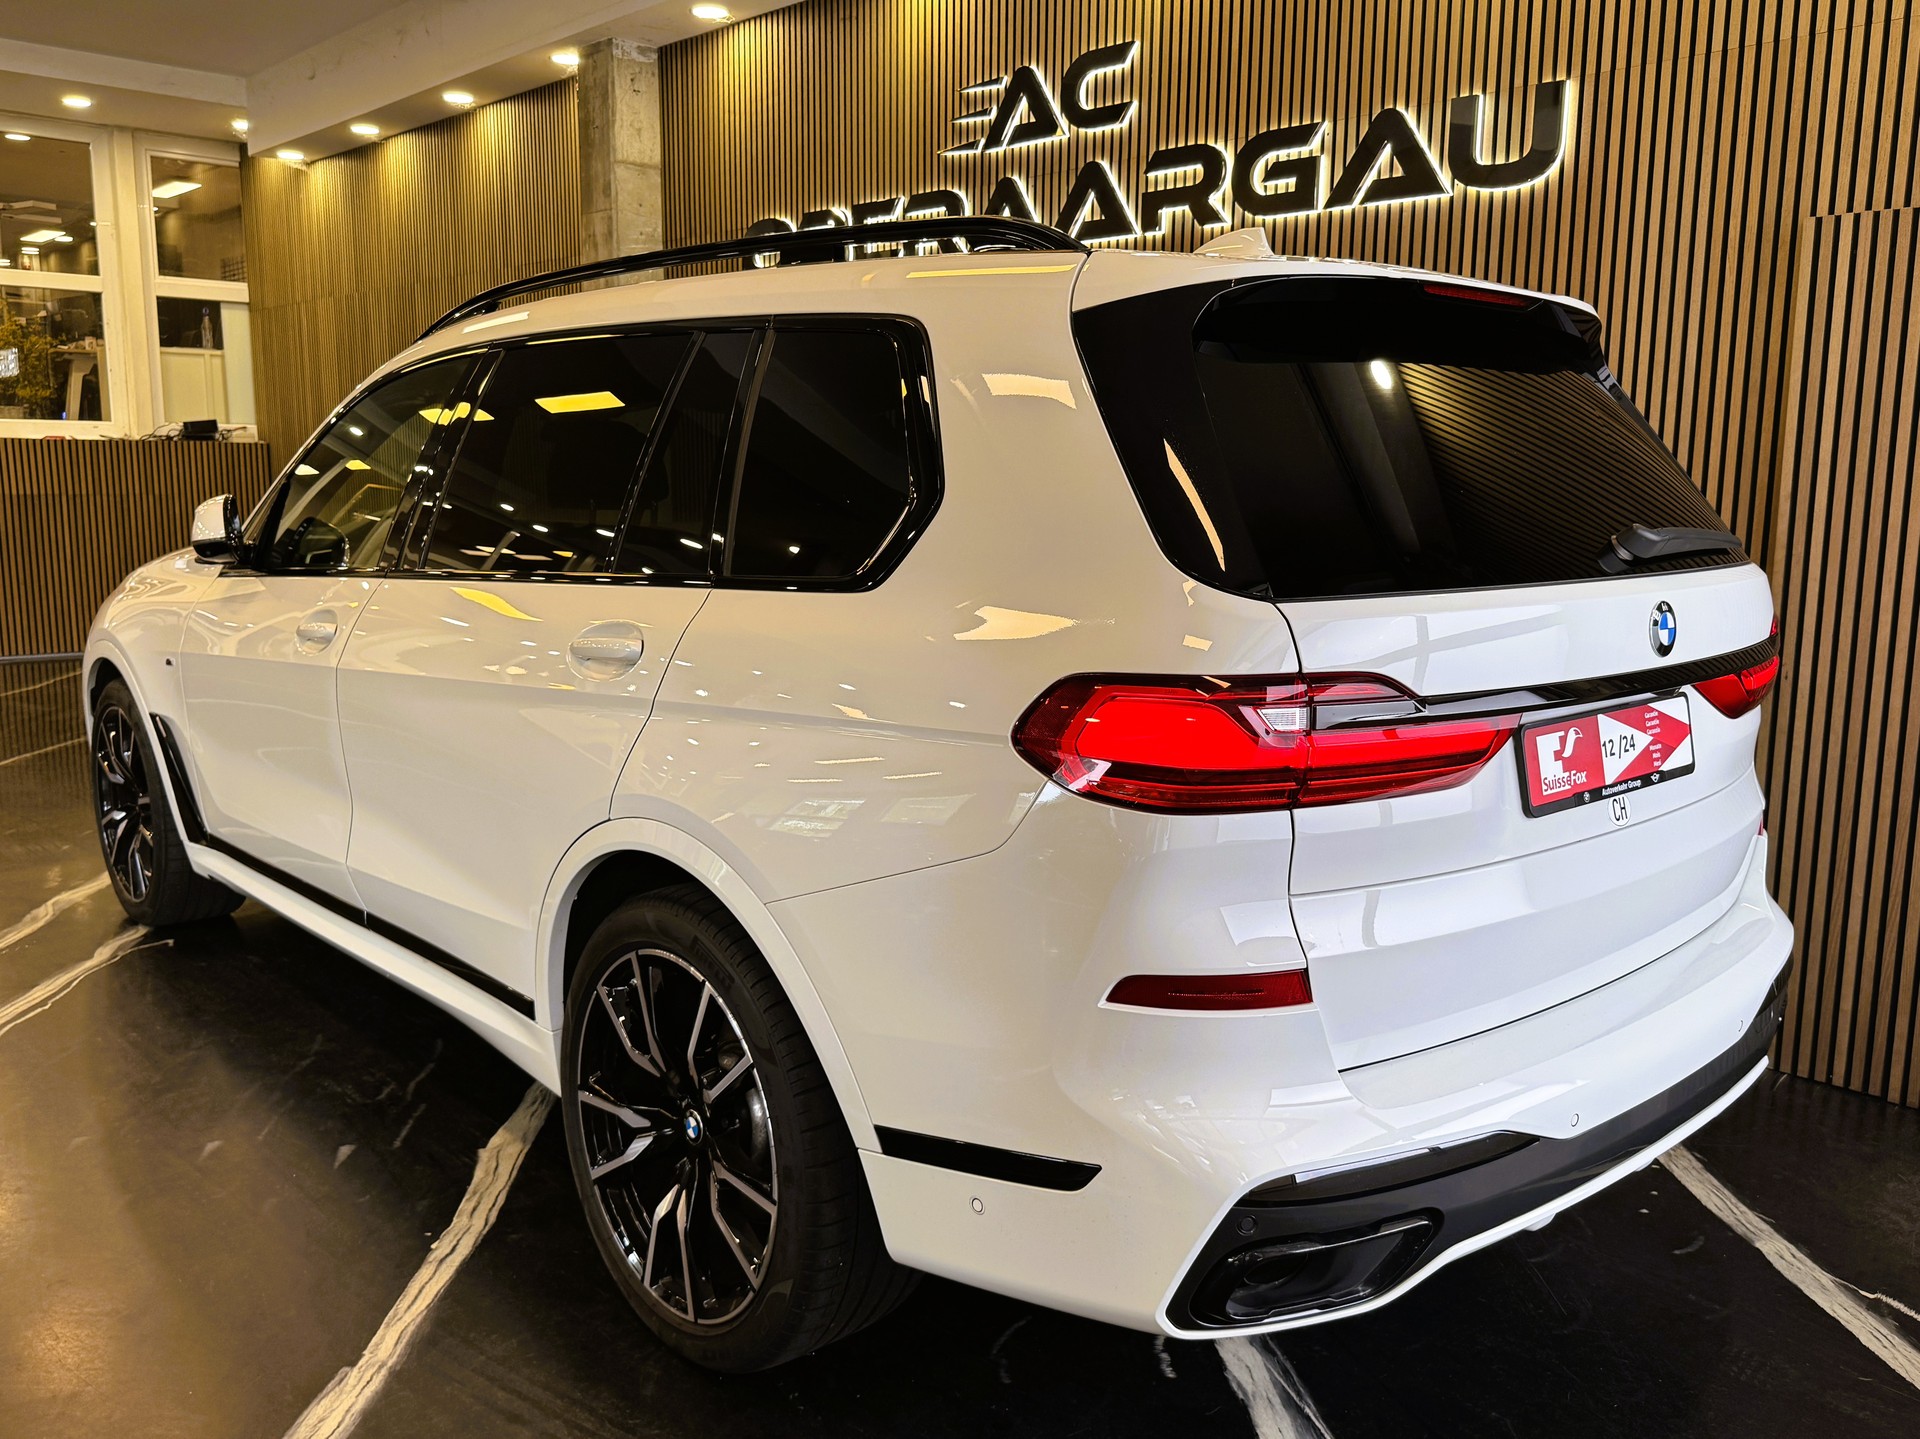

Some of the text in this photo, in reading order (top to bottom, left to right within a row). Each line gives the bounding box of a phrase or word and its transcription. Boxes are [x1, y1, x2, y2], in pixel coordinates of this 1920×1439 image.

[982, 40, 1139, 153] AC
[1602, 738, 1616, 758] 12
[1542, 770, 1587, 793] SuisseFox
[1602, 779, 1642, 796] Autoverkehr Group
[1612, 796, 1628, 821] CH
